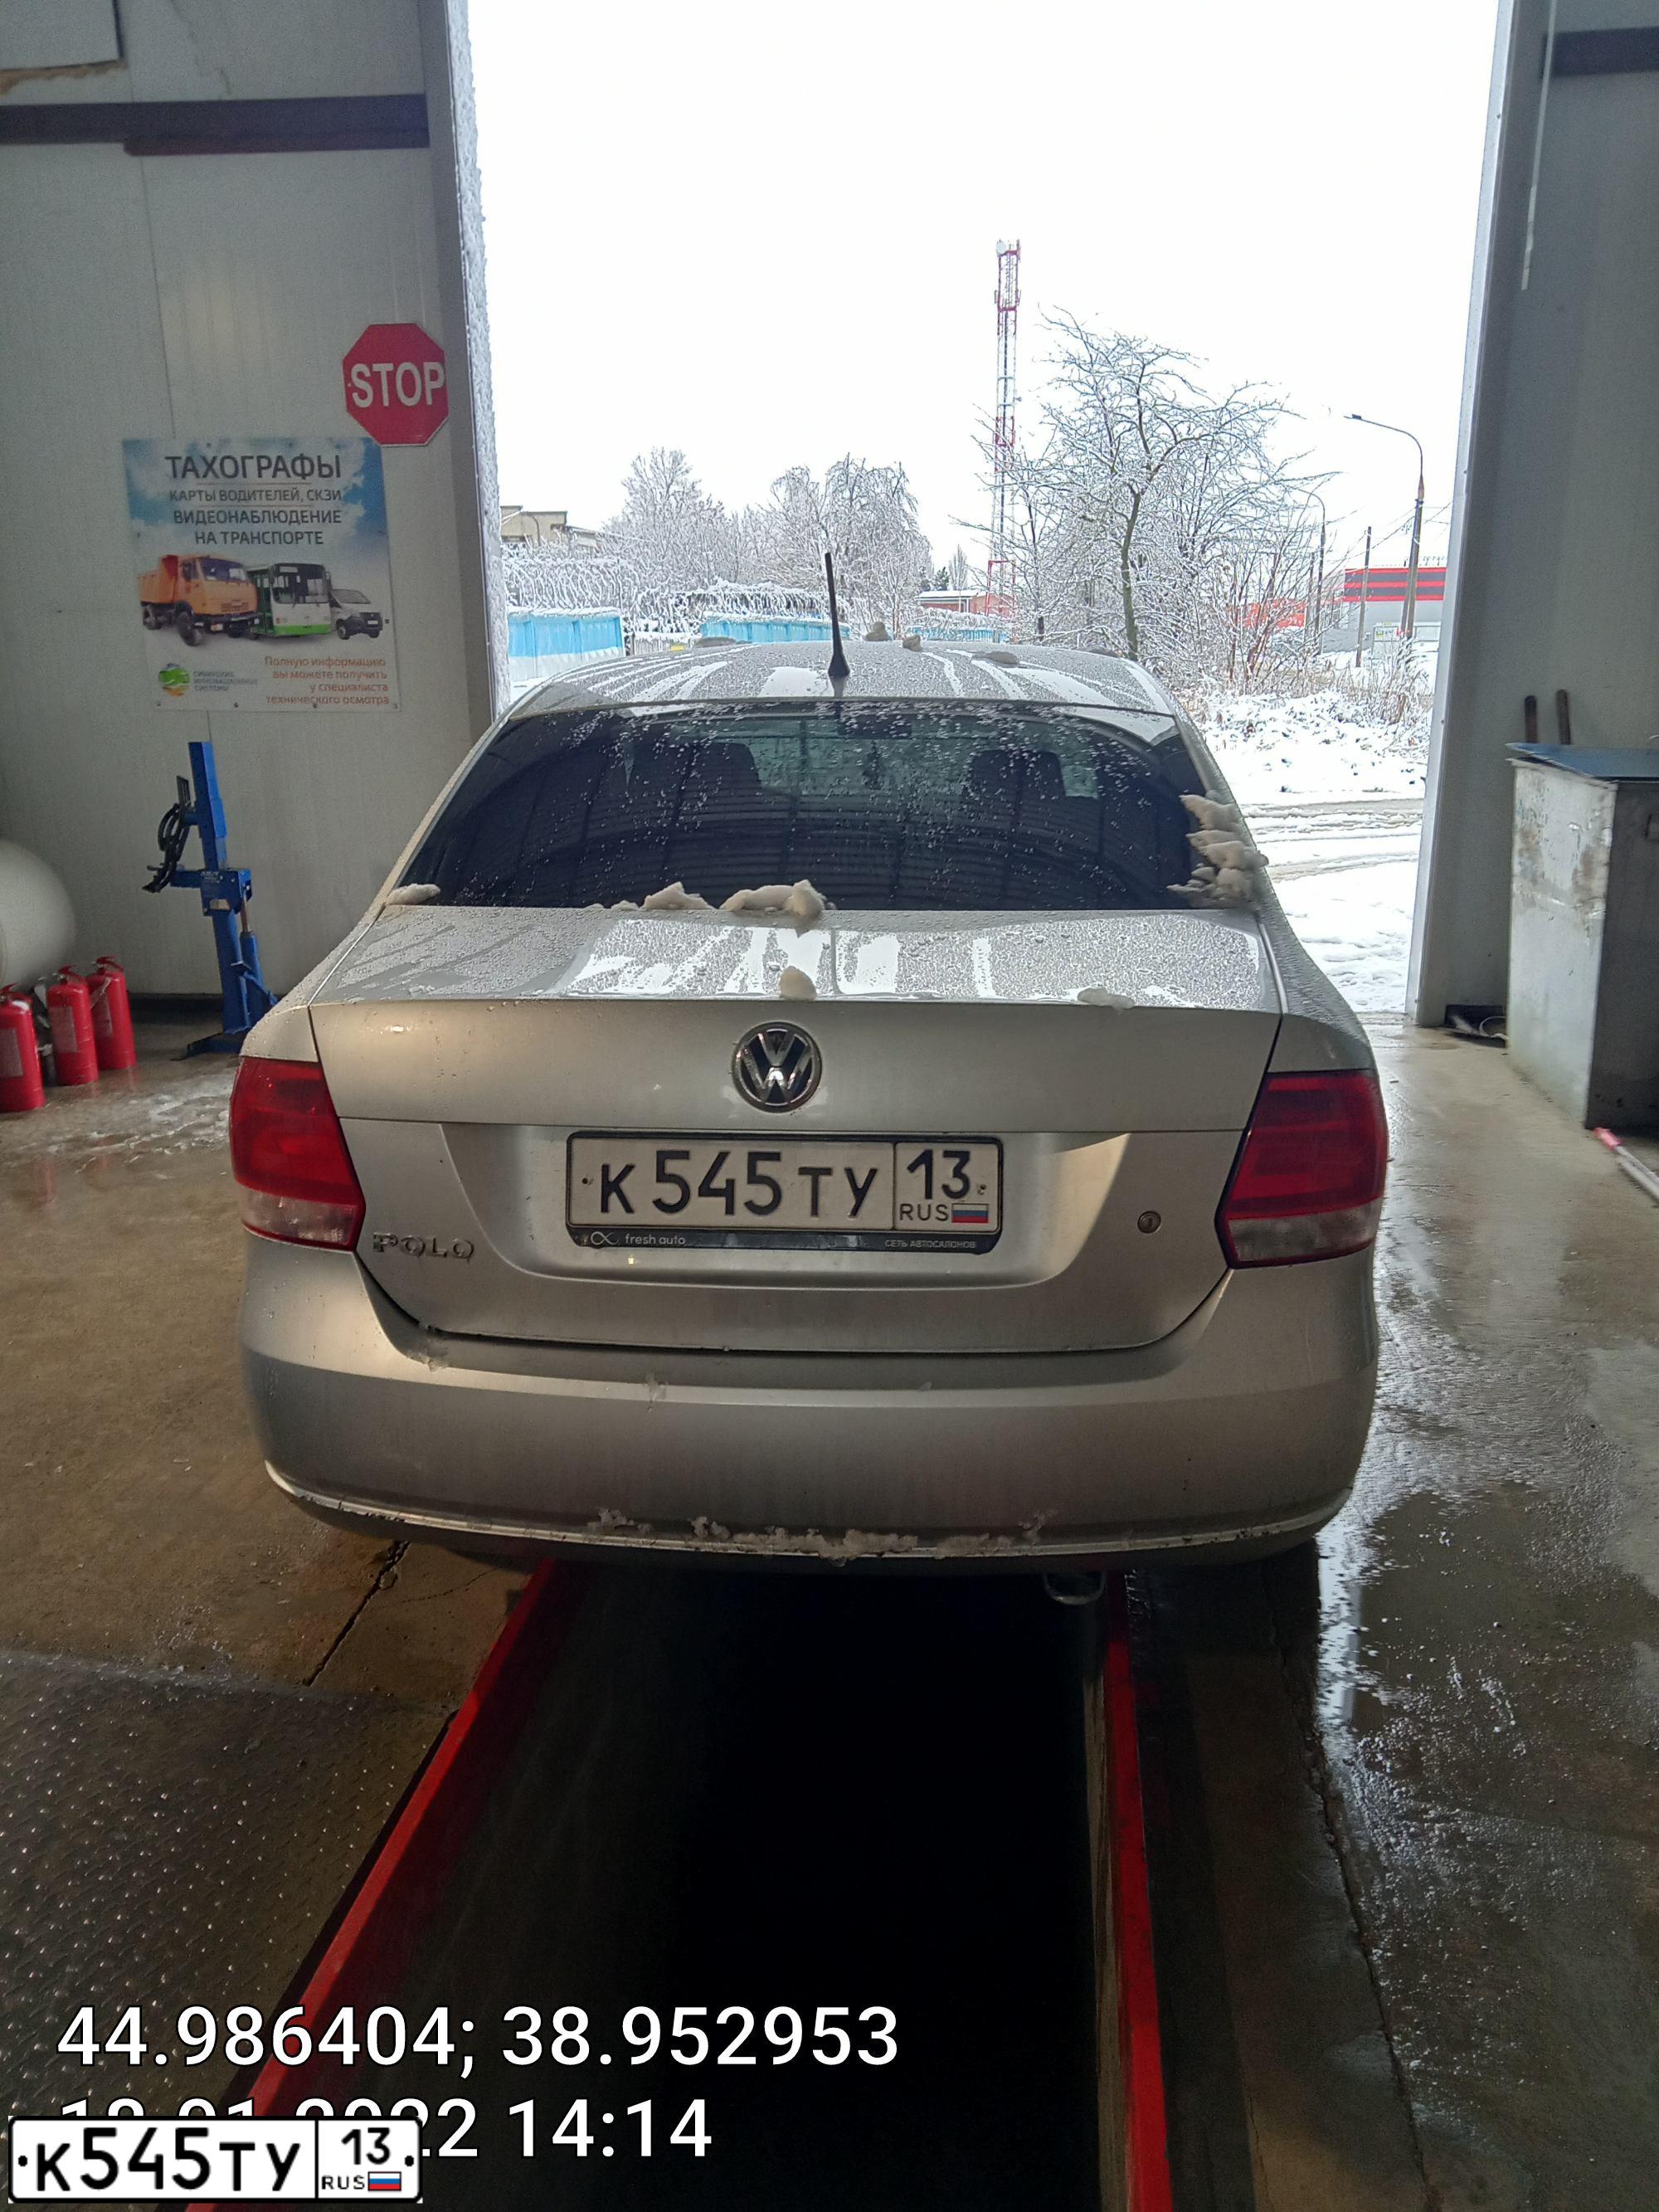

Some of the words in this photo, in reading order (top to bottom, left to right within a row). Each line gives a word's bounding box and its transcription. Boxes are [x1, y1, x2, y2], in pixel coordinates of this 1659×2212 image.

[351, 362, 445, 408] STOP
[164, 453, 341, 480] ТАХОГРАФЫ
[169, 490, 216, 502] КАРТЫ
[219, 487, 304, 503] ВОДИТЕЛЕЙ,
[306, 490, 341, 501] СКЗИ
[173, 509, 342, 525] ВИДЕОНАБЛЮДЕНИЕ
[195, 531, 217, 544] НА
[220, 531, 324, 544] ТРАНСПОРТЕ
[265, 656, 309, 668] Полную
[311, 655, 386, 668] информацию
[288, 670, 333, 679] можете
[335, 670, 387, 680] получить
[318, 684, 389, 693] специалиста
[265, 695, 340, 704] технического
[343, 695, 389, 705] осмотра
[907, 1148, 972, 1201] 13
[899, 1203, 949, 1222] RUS
[373, 1232, 474, 1259] POLO
[625, 1234, 656, 1245] fresh
[658, 1235, 686, 1245] auto
